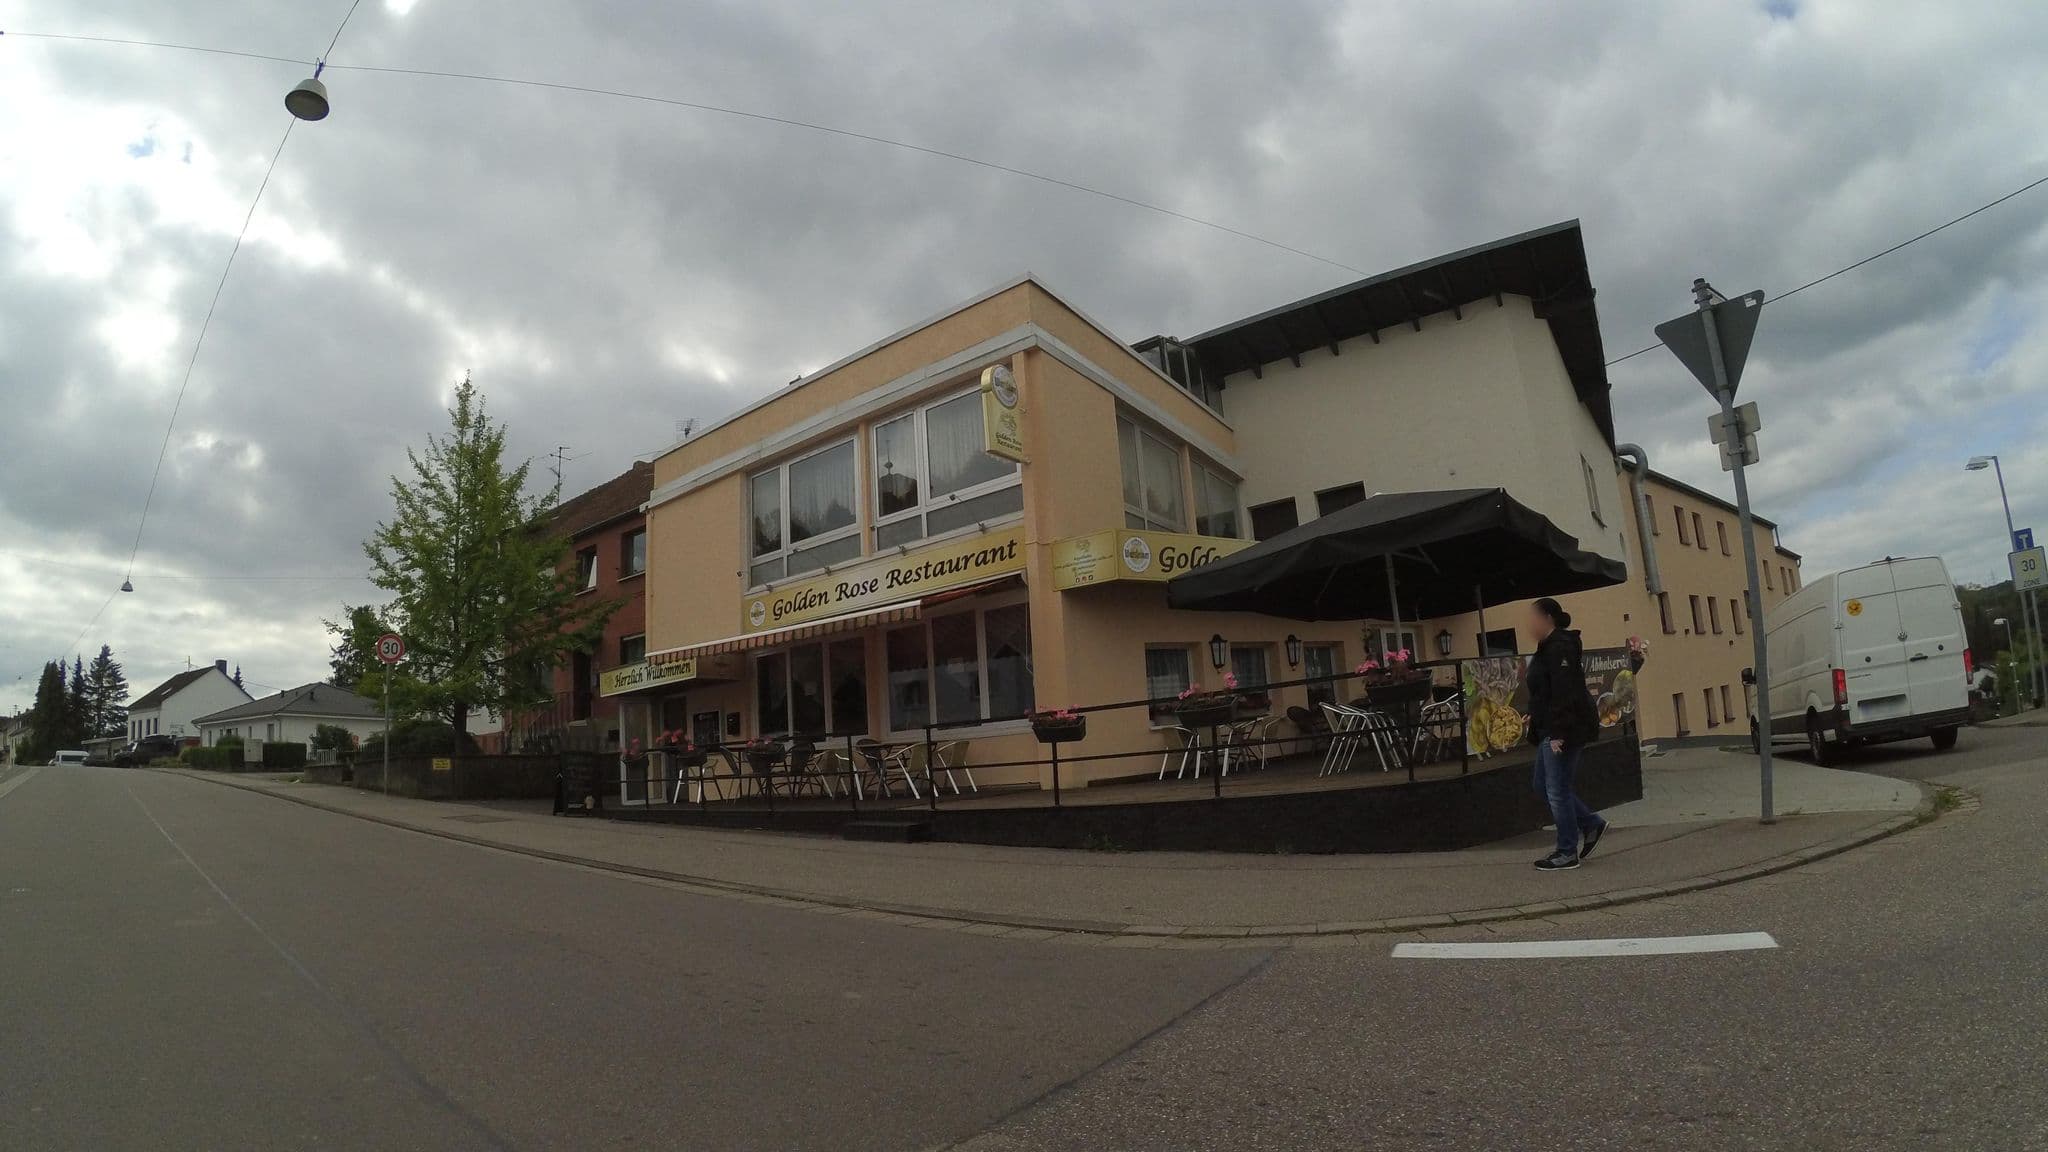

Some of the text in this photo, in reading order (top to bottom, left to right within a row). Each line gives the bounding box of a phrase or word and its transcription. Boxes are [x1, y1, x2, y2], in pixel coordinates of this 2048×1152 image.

[2022, 558, 2036, 572] 30
[772, 587, 830, 621] Golden
[835, 577, 880, 602] Rose
[886, 538, 1018, 590] Restaurant
[382, 641, 399, 655] 30
[614, 661, 692, 688] Herzlich Willkommen
